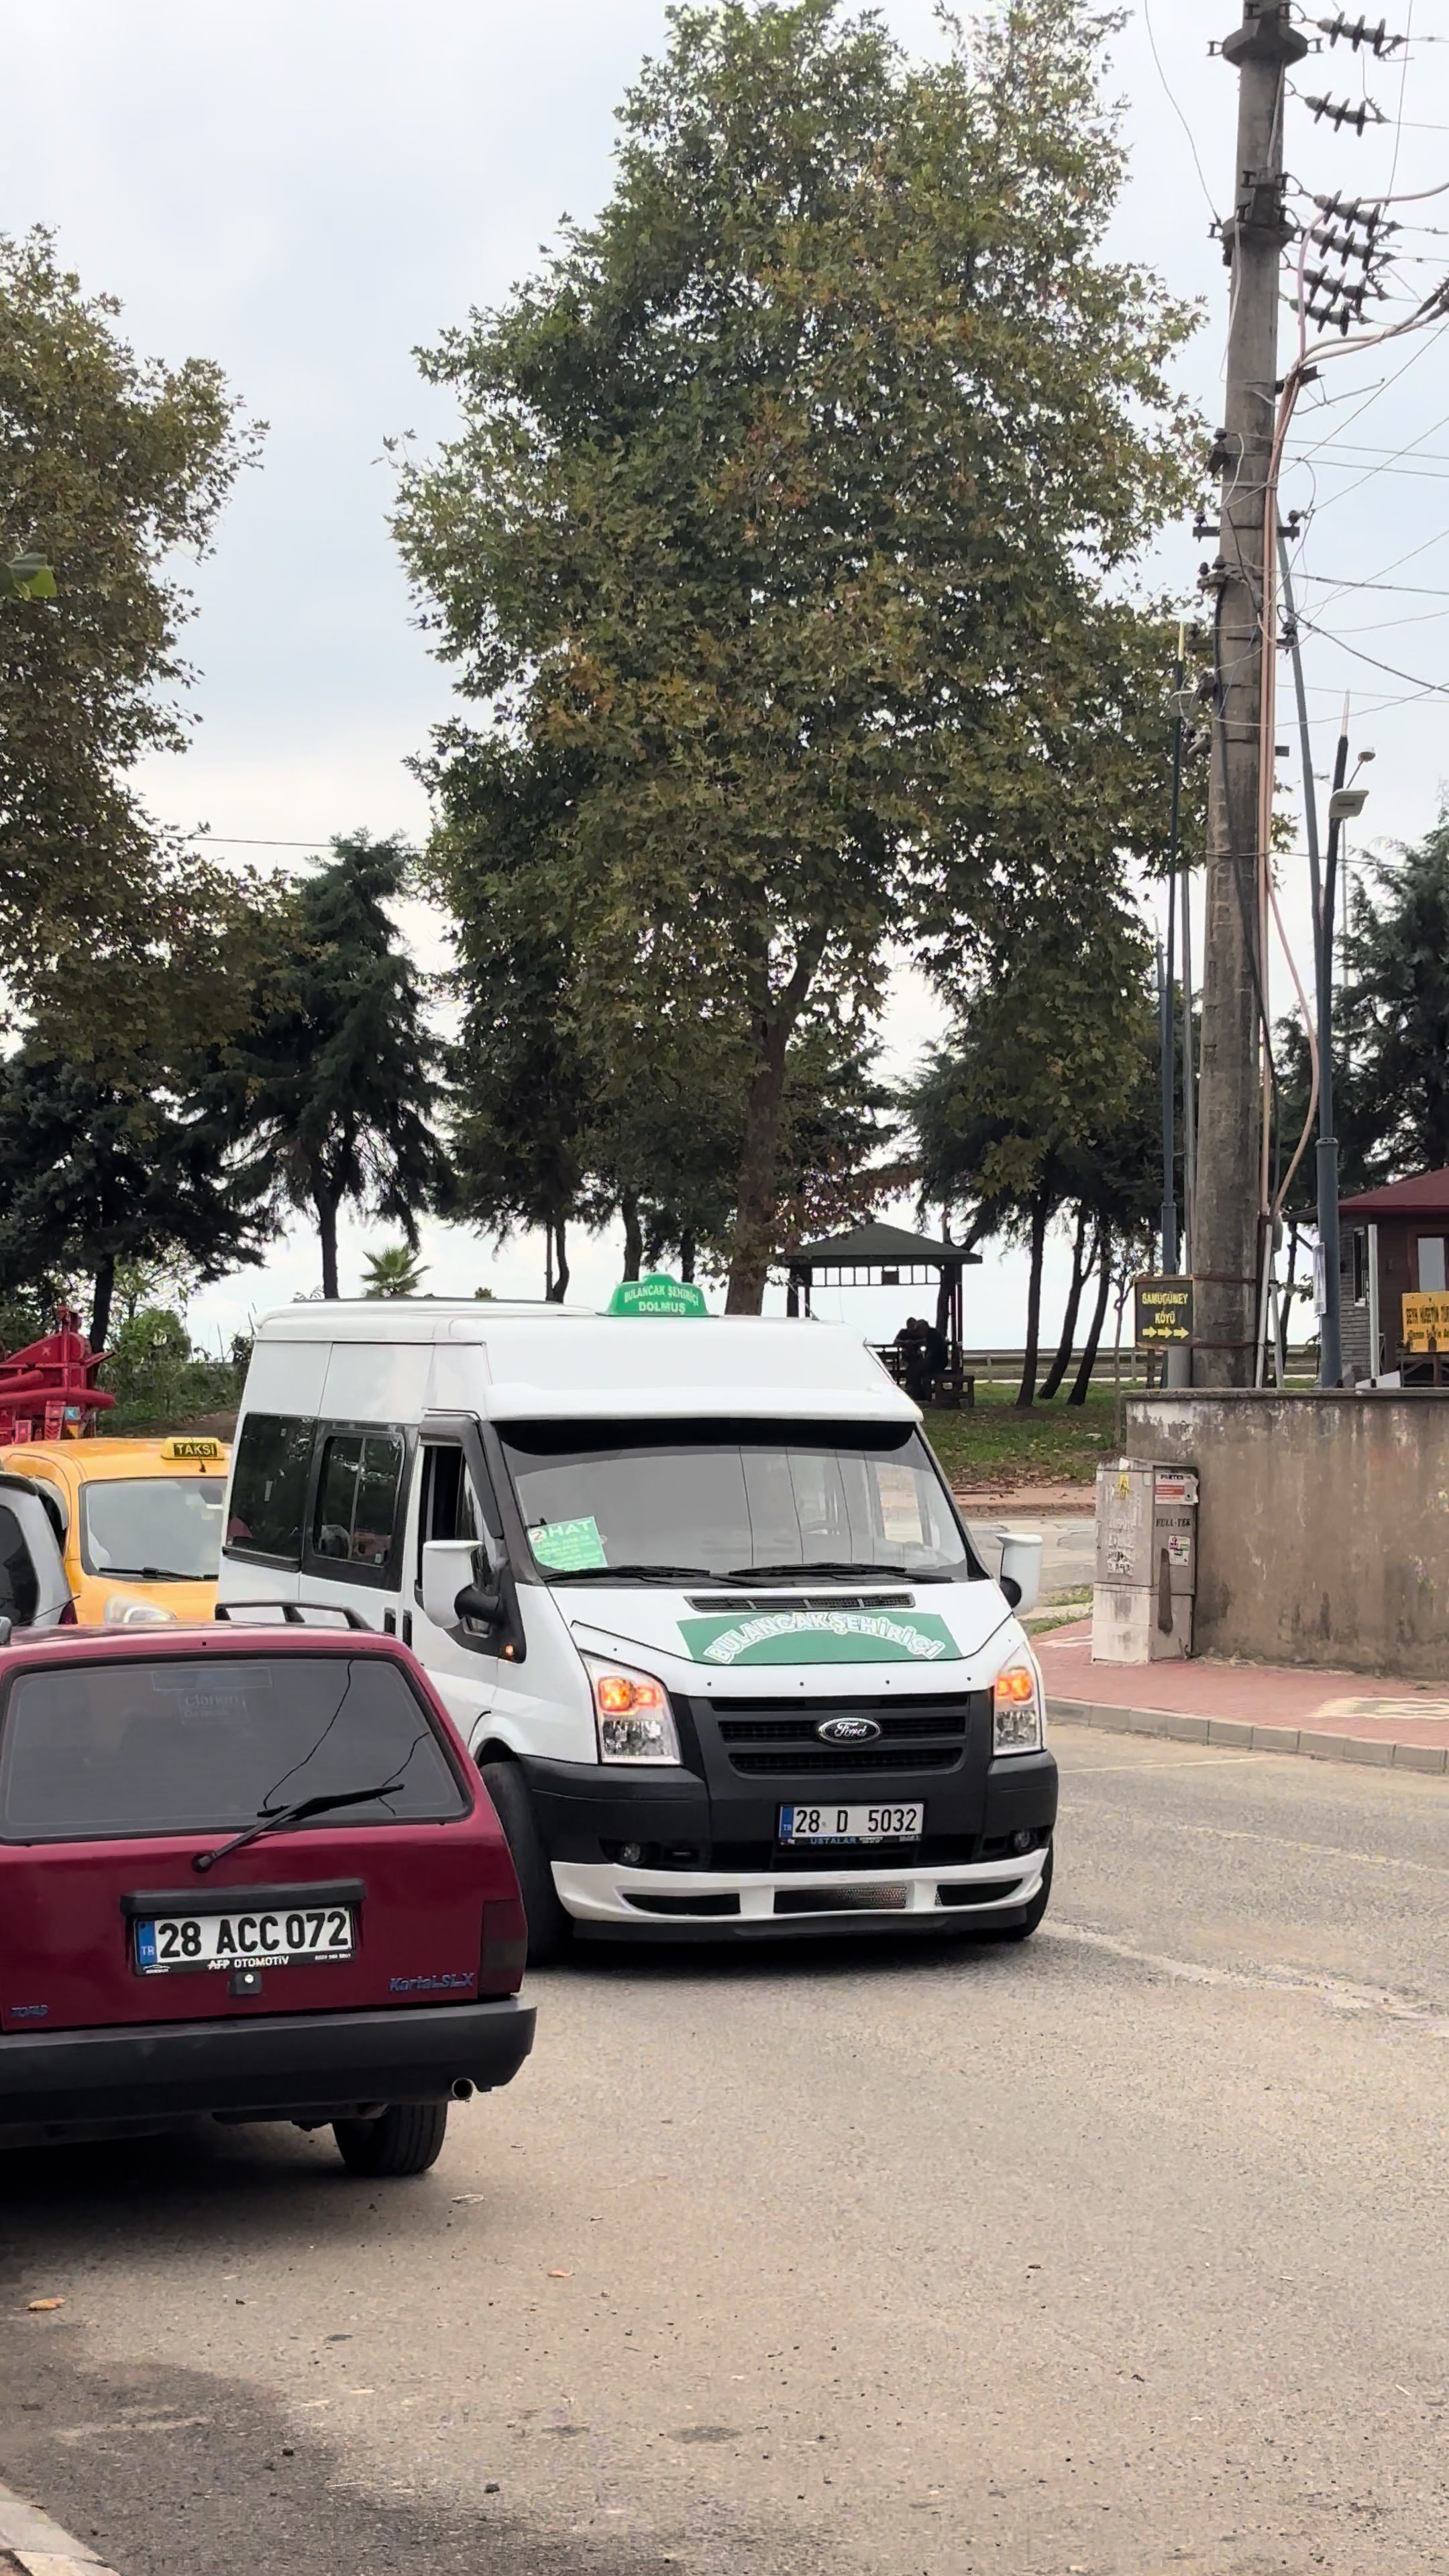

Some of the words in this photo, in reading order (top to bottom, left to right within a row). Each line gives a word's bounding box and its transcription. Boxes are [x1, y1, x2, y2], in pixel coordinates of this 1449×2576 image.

[639, 1301, 686, 1316] DOLMUŞ
[703, 1611, 829, 1664] BULANCAK
[829, 1612, 945, 1660] ŞEHİRİÇİ
[834, 1722, 867, 1737] Ford
[795, 1809, 820, 1833] 28
[837, 1809, 848, 1833] D
[867, 1809, 917, 1832] 5032
[141, 1945, 155, 1956] TR
[158, 1921, 203, 1958] 28
[216, 1916, 280, 1955] ACC
[284, 1911, 349, 1949] 072
[233, 1955, 289, 1969] OTOMOTİV
